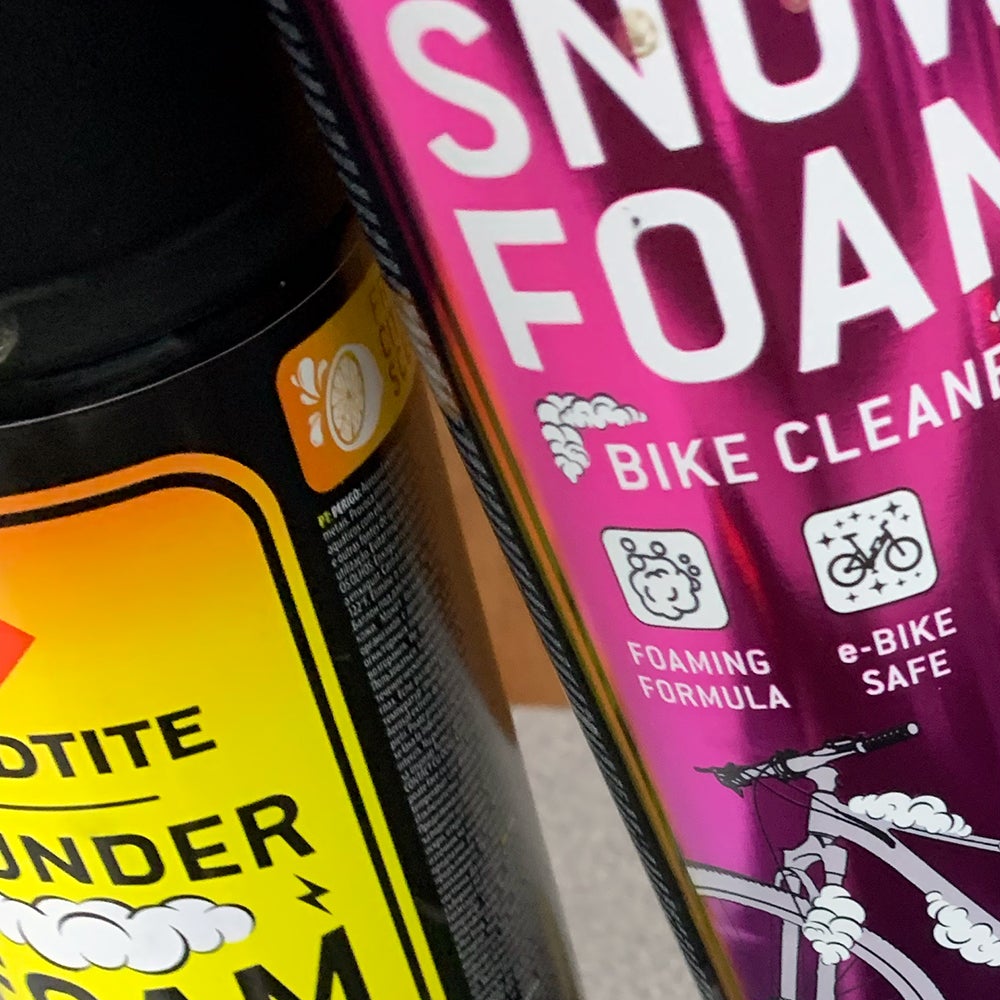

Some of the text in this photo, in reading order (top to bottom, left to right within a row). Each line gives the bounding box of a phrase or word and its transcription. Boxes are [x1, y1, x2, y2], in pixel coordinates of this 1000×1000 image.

[605, 432, 758, 492] BIKE
[627, 640, 771, 675] FOAMING
[837, 608, 957, 664] e-BIKE
[637, 676, 791, 710] FORMULA
[862, 649, 952, 697] SAFE
